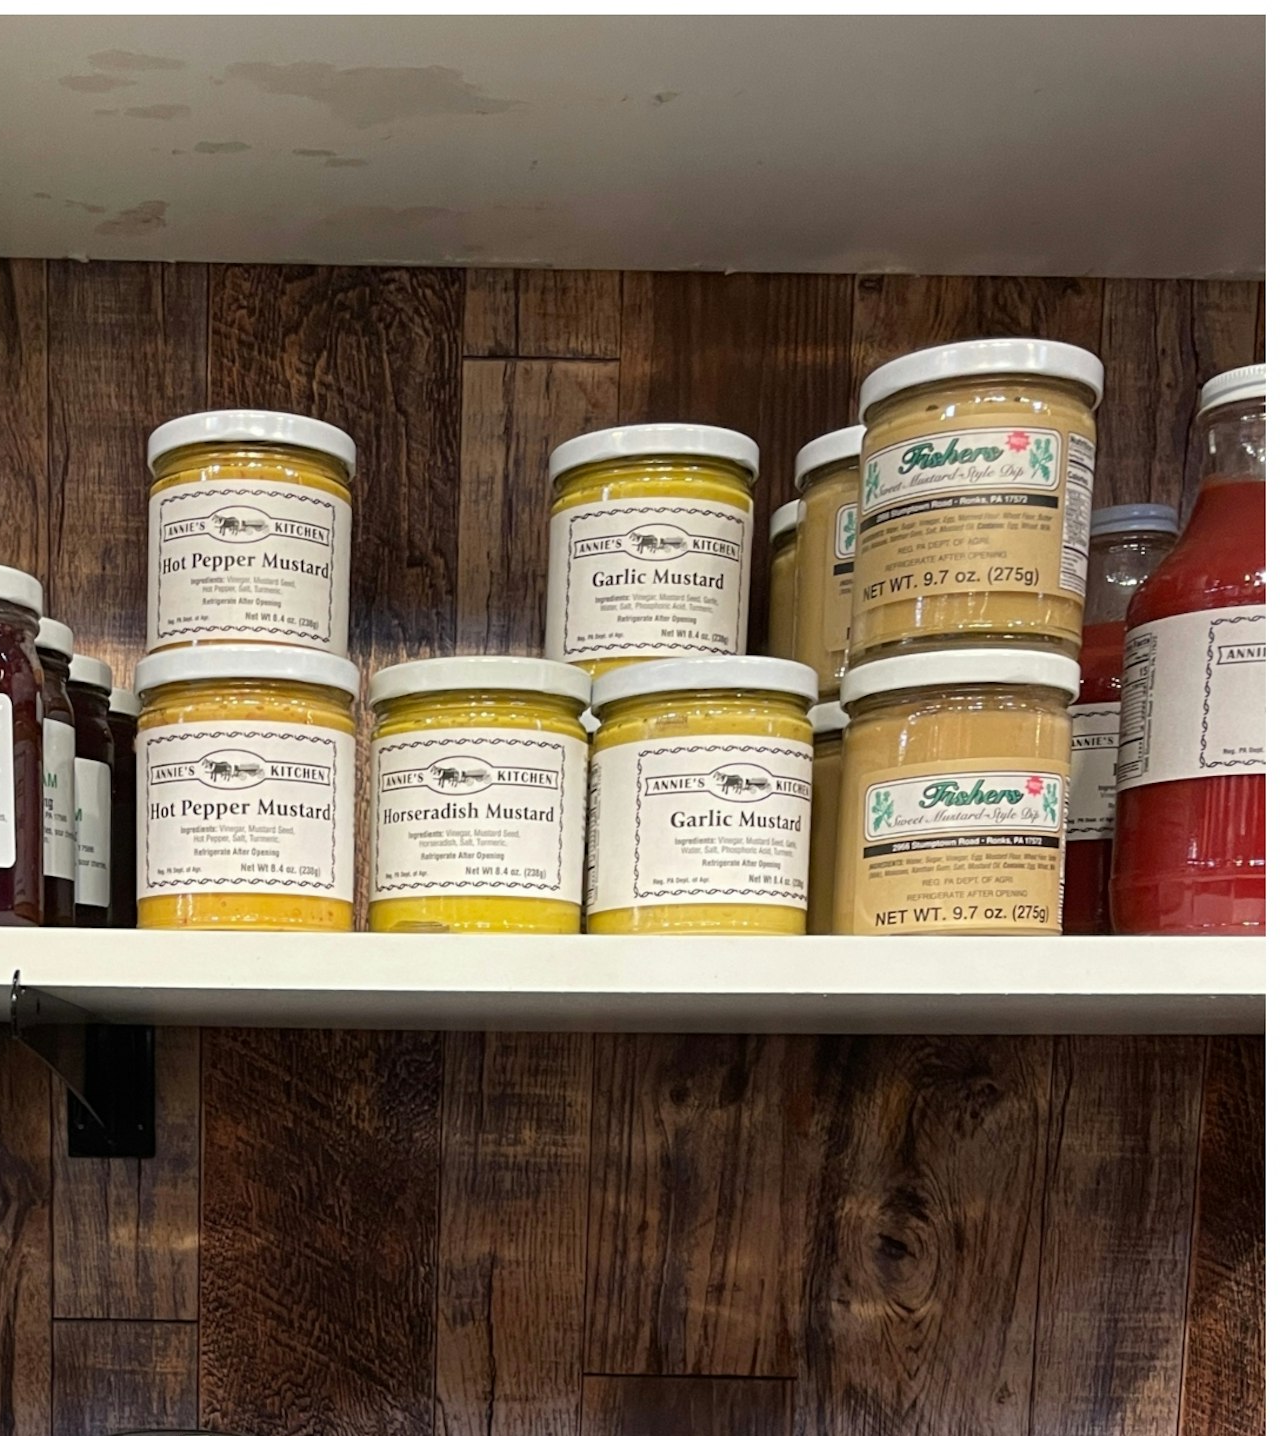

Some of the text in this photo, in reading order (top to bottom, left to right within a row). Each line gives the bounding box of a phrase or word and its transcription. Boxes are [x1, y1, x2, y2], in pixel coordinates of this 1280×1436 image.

[168, 521, 325, 541] ANNIE'S KITCHEN
[579, 539, 736, 557] ANNIE'S KITCHEN
[162, 553, 329, 578] Hot Pepper Mustard
[593, 569, 724, 589] Garlic Mustard
[863, 566, 1040, 602] NET WT. 9.7 oz. (275g)
[1227, 648, 1266, 660] ANNI
[155, 765, 325, 781] ANNIE'S KITCHEN
[386, 770, 553, 787] ANNIE'S KITCHEN
[653, 777, 705, 791] ANNIE'S
[151, 799, 330, 821] Hot Pepper Mustard
[383, 803, 554, 825] Horseradish Mustard
[670, 810, 801, 832] Garlic Mustard
[241, 863, 255, 872] Net
[876, 904, 1049, 927] NET WT. 9.7 oz. (275g)
